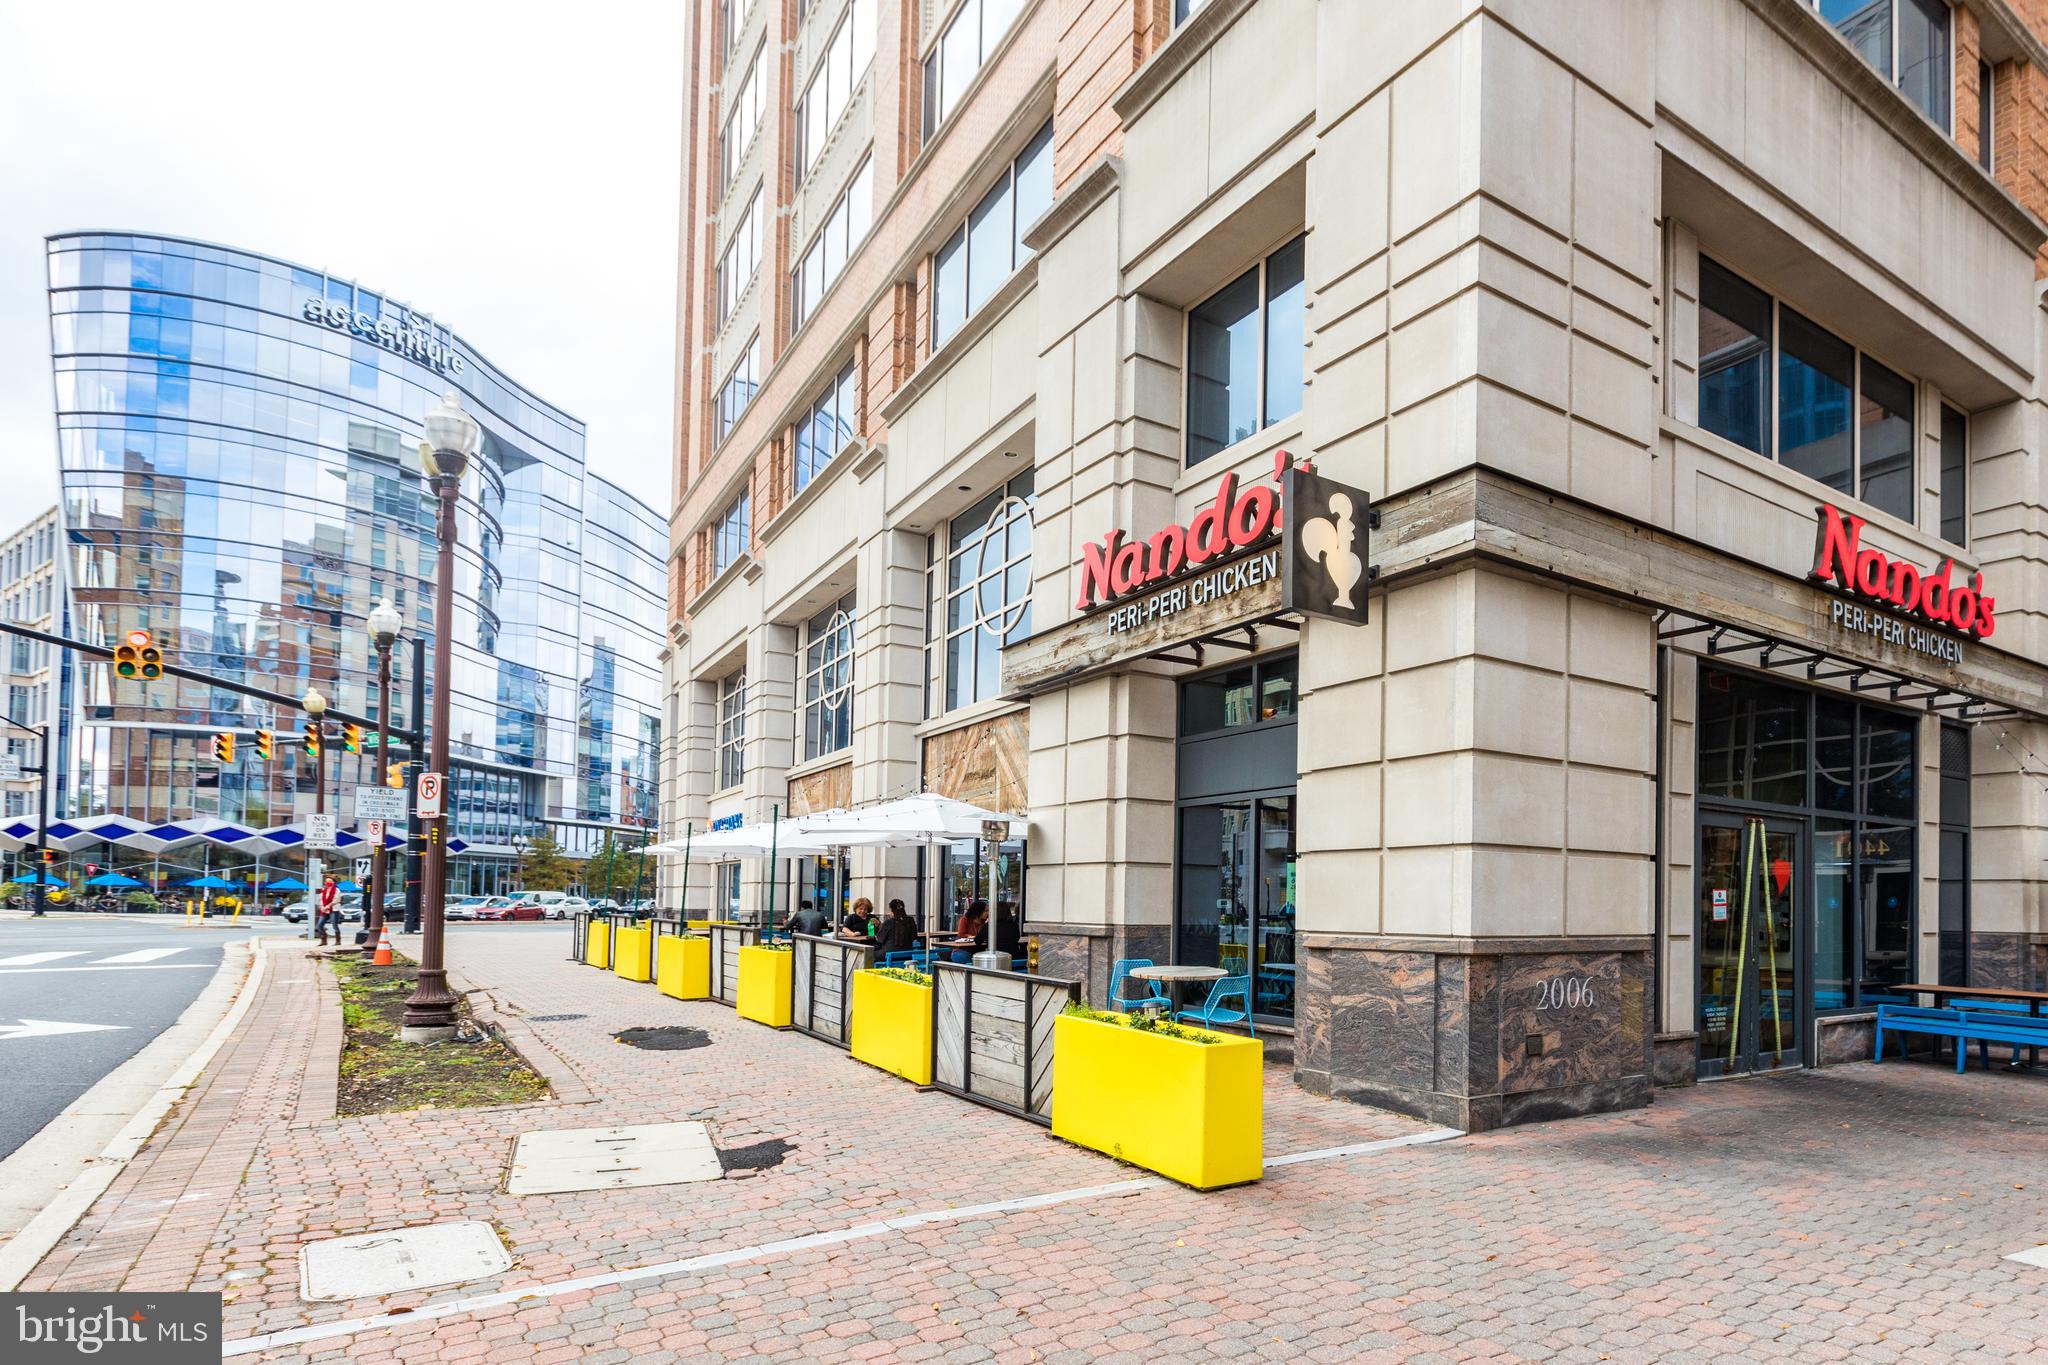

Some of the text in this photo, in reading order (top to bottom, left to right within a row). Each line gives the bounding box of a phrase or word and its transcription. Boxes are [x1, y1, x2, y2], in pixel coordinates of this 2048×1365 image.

[304, 296, 464, 375] accenture
[1191, 551, 1278, 606] CHICKEN
[1808, 503, 1995, 640] Nando's
[1908, 627, 1964, 665] CHICKEN
[1536, 976, 1594, 1010] 2006
